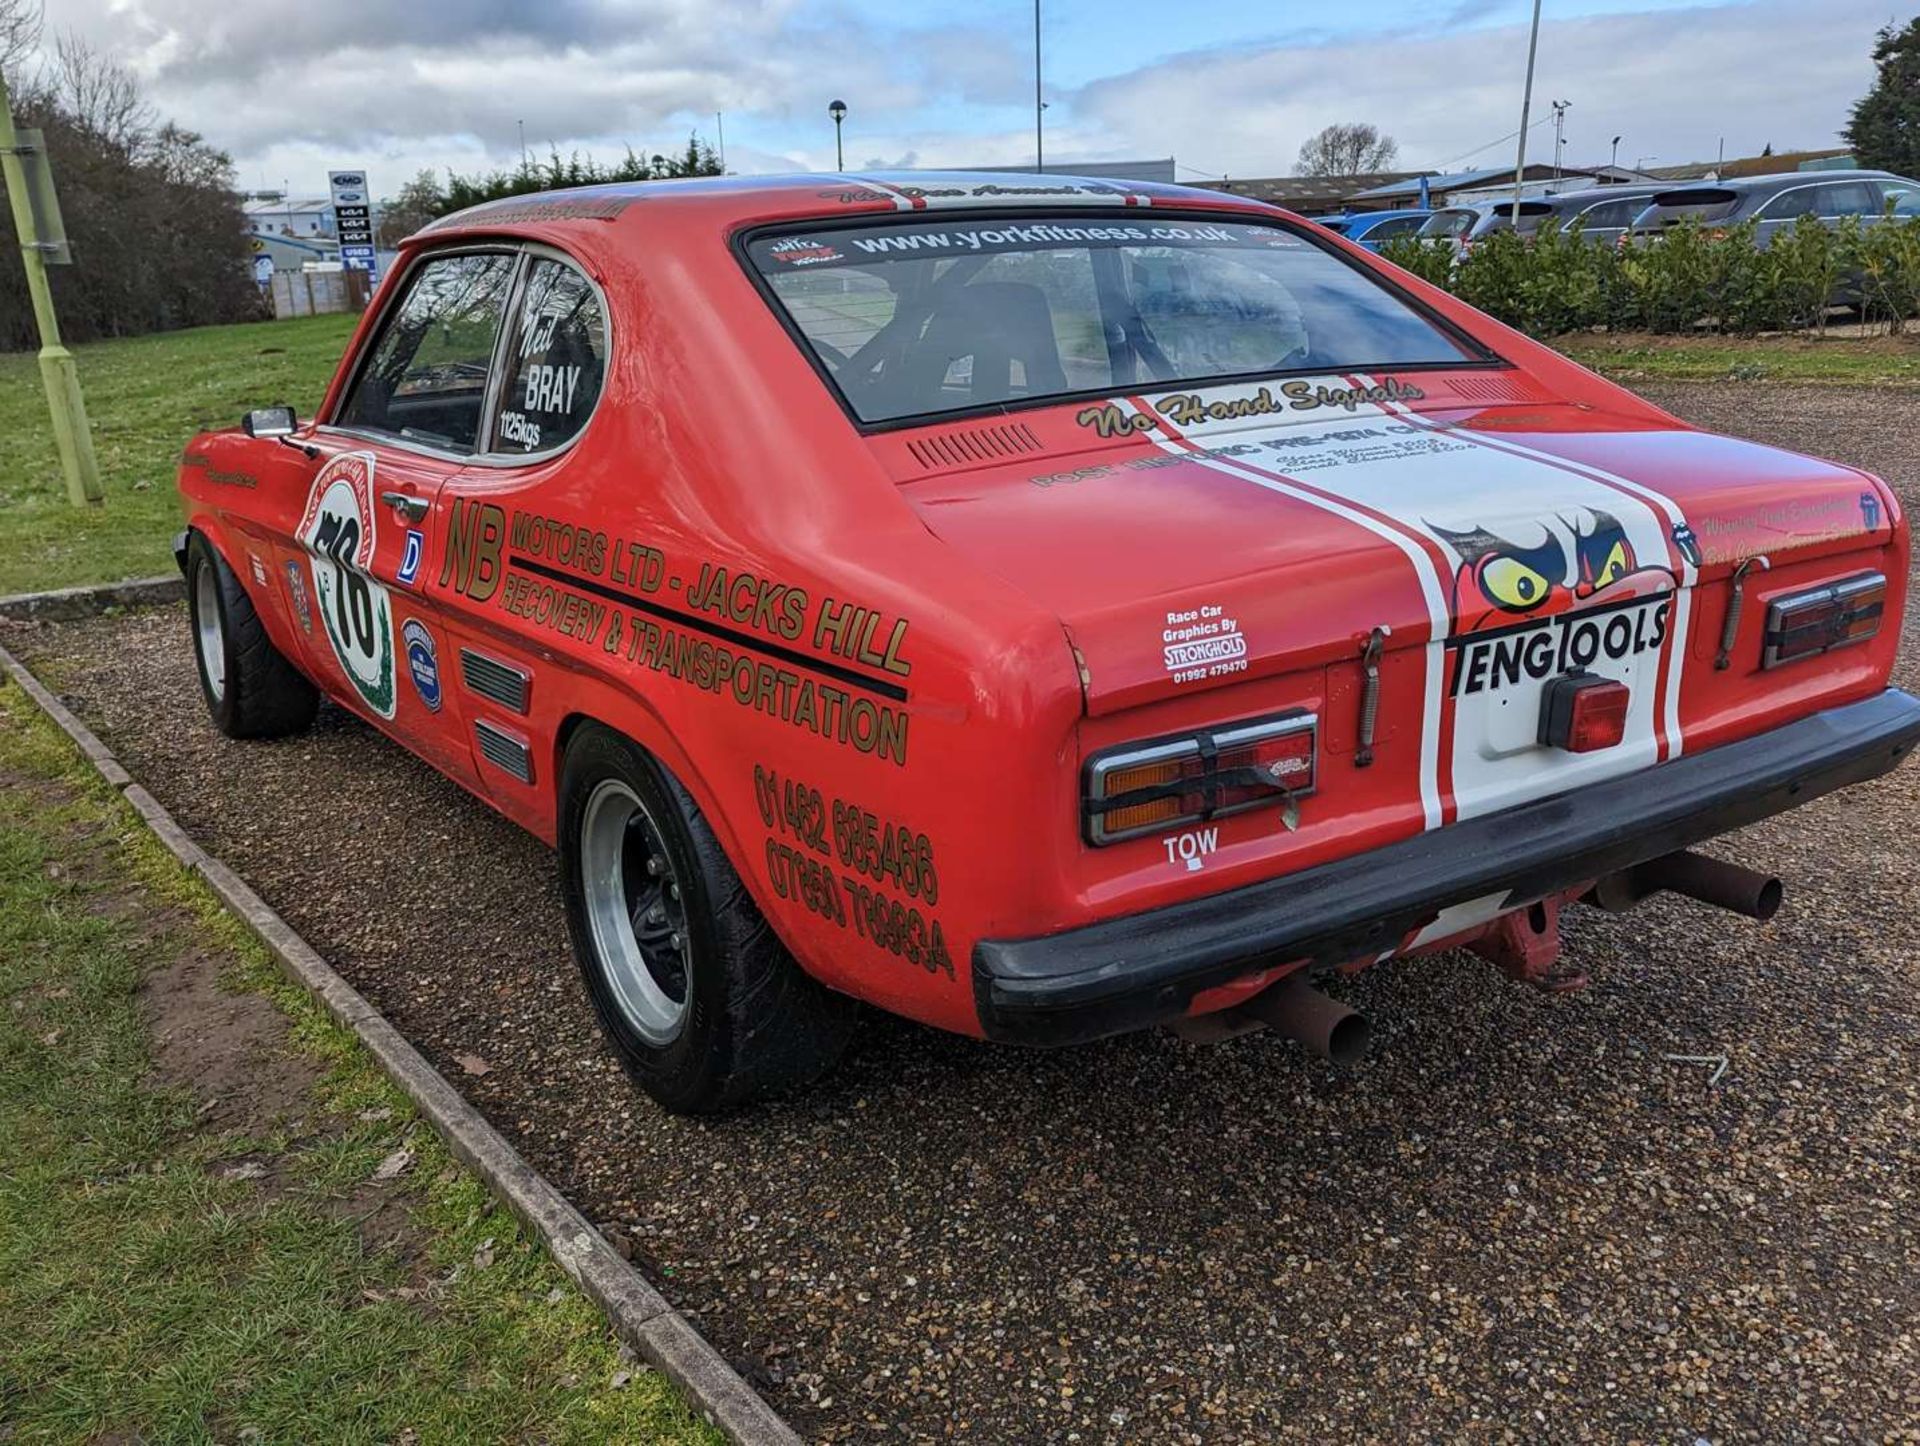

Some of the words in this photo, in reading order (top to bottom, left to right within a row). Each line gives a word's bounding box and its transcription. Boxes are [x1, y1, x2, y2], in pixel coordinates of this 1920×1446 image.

[852, 224, 1238, 254] www.yorkfitness.co.uk
[519, 310, 559, 358] Neil
[525, 364, 580, 414] BRAY
[1077, 406, 1156, 438] No
[1155, 388, 1281, 427] Hand
[1291, 378, 1425, 415] Signals
[501, 410, 540, 452] 1125kgs
[402, 537, 418, 576] D
[439, 498, 505, 602] NB
[511, 511, 607, 576] MOTORS
[611, 539, 665, 594] LTD
[686, 563, 807, 639] JACKS
[814, 599, 912, 676] HILL
[1163, 622, 1219, 642] Graphics
[1221, 619, 1236, 632] By
[1167, 612, 1198, 625] Race
[1200, 606, 1222, 618] Car
[499, 575, 605, 644] RECOVERY
[605, 615, 623, 653] &
[628, 619, 908, 766] TRANSPORTATION
[1164, 635, 1247, 667] STRONGHOLD
[1173, 667, 1207, 683] 01992
[1209, 660, 1248, 677] 479470
[755, 765, 831, 857] 01462
[1163, 827, 1218, 864] TOW
